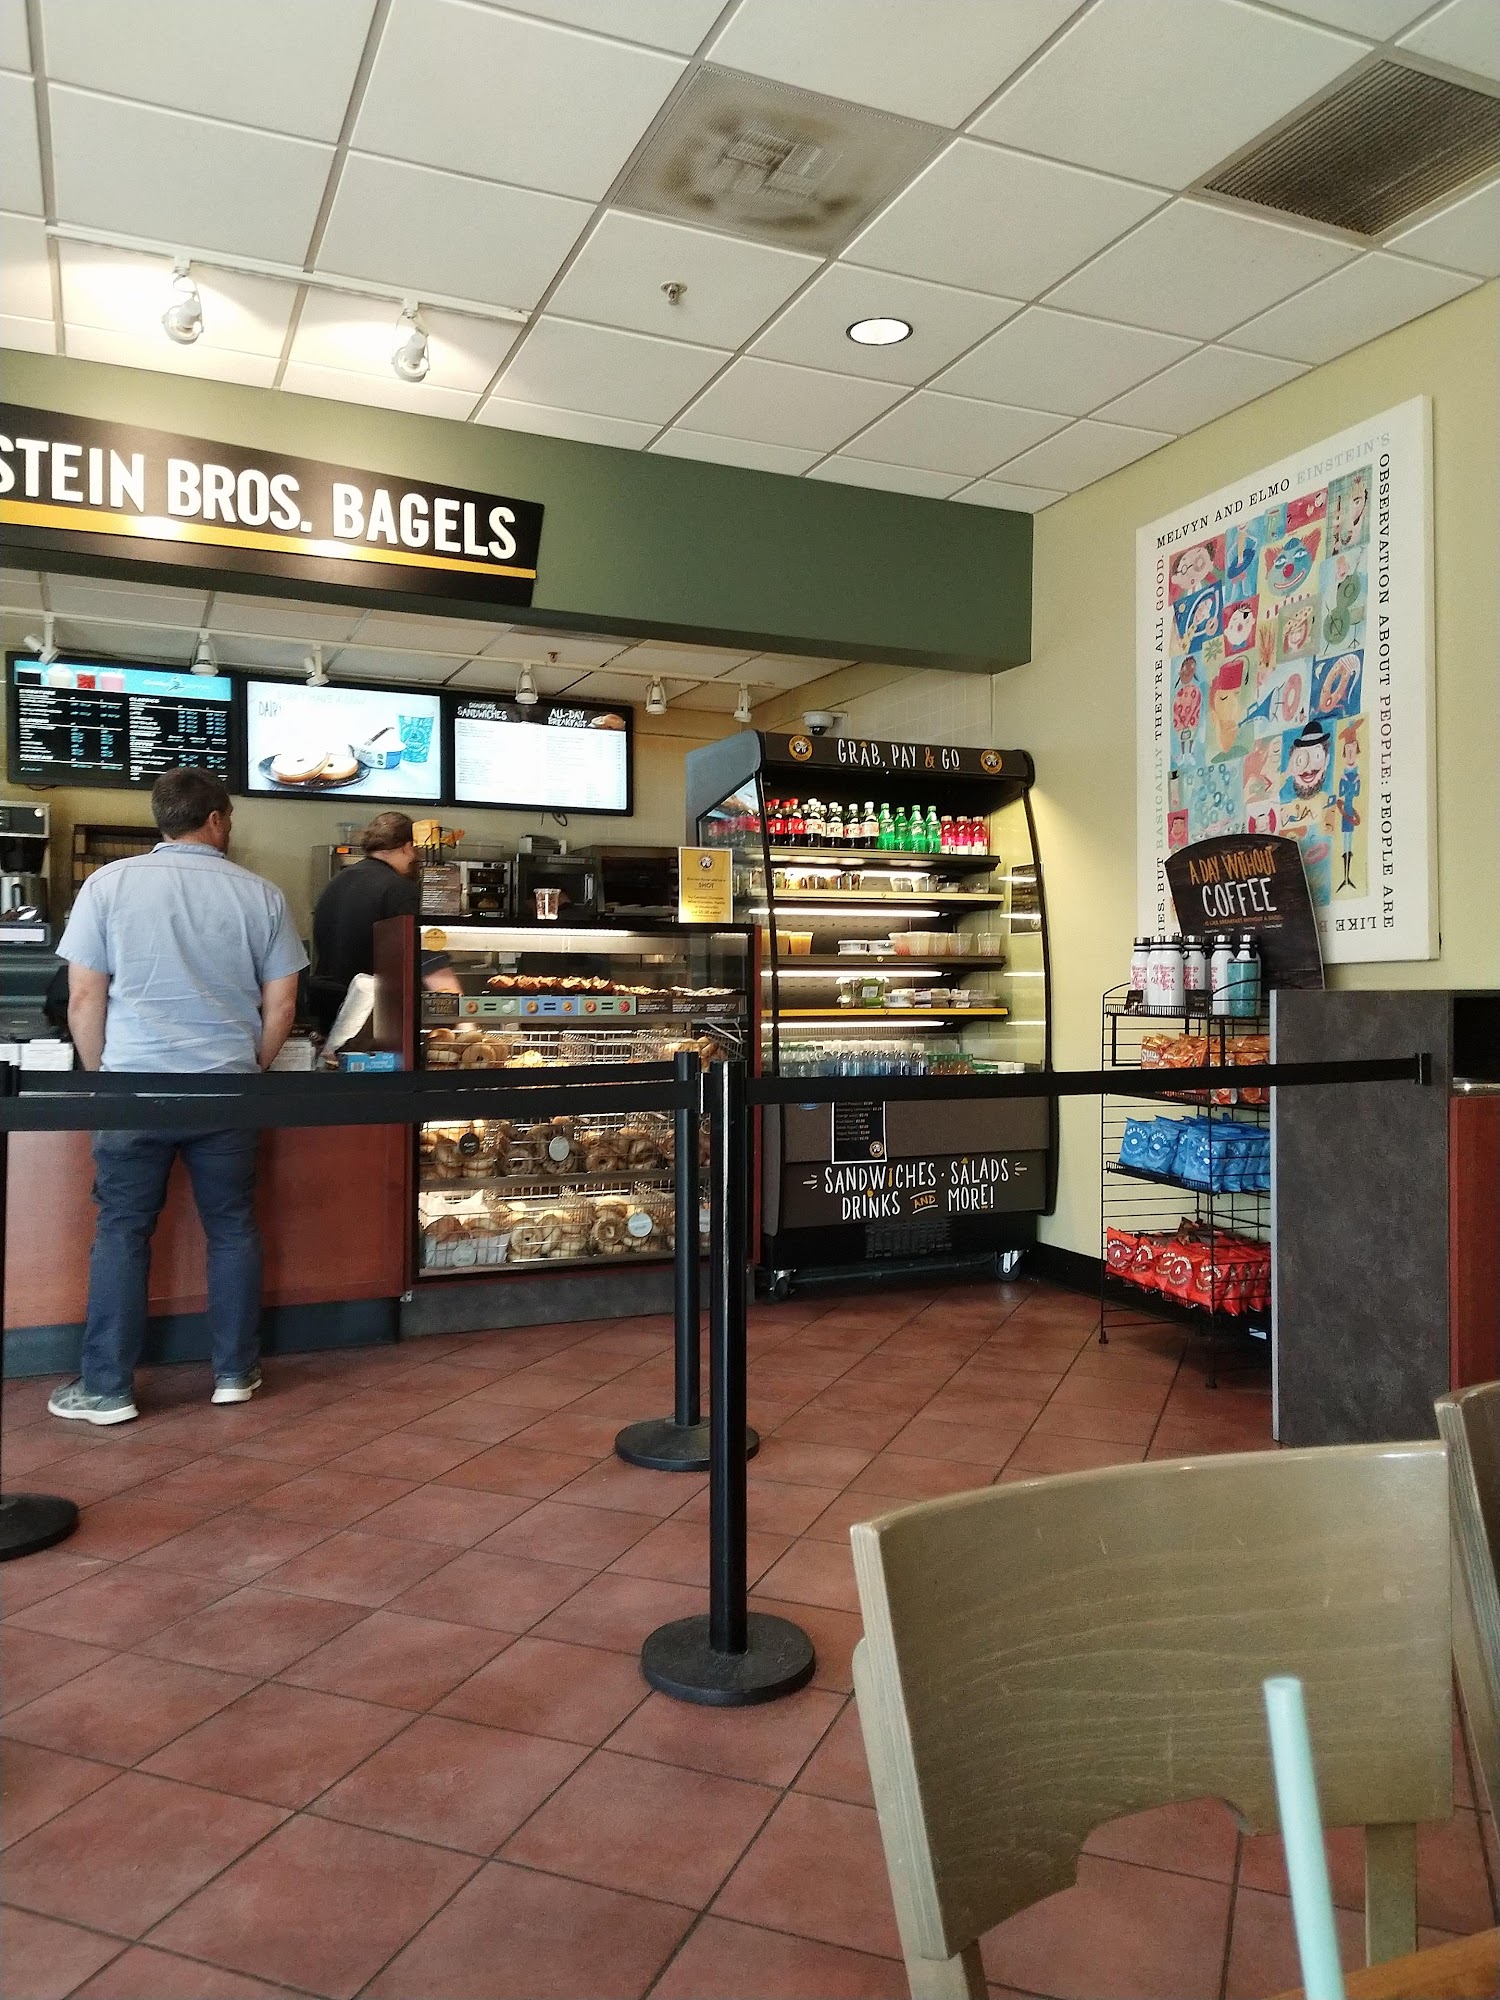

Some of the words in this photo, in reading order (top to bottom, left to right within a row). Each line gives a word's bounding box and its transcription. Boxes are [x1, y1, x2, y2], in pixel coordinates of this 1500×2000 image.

[167, 457, 313, 533] BROS.
[332, 482, 518, 560] BAGELS
[1156, 514, 1209, 549] MELVYN
[1214, 499, 1243, 523] AND
[1248, 478, 1290, 507] ELMO
[1296, 432, 1391, 486] EINSTEIN'S
[1379, 453, 1390, 604] OBSERVATION
[1155, 554, 1165, 611] GOOD.
[1155, 617, 1164, 652] ALL
[1379, 614, 1390, 686] ABOUT
[457, 706, 507, 720] SANDWICHES
[549, 708, 585, 720] ALL-DAY
[1154, 659, 1163, 741] THEY'RE
[547, 716, 587, 728] BREAKFAST
[1380, 694, 1392, 786] PEOPLE:
[838, 738, 886, 767] GRAB,
[891, 744, 916, 768] PAY
[924, 746, 935, 769] &
[941, 748, 960, 770] GO
[1155, 747, 1164, 850] BASICALLY
[1380, 792, 1393, 876] PEOPLE
[1157, 857, 1165, 893] BUT
[1188, 860, 1201, 886] A
[1198, 855, 1221, 884] DAY
[1221, 845, 1277, 880] WITHOUT
[1202, 877, 1278, 917] COFFEE
[1382, 886, 1394, 928] ARE
[1335, 916, 1377, 932] LIKE
[824, 1161, 937, 1195] SANDWICHES
[950, 1157, 1009, 1186] SALADS
[841, 1190, 901, 1221] DRINKS
[914, 1195, 936, 1209] AND
[948, 1183, 994, 1212] MORE!
